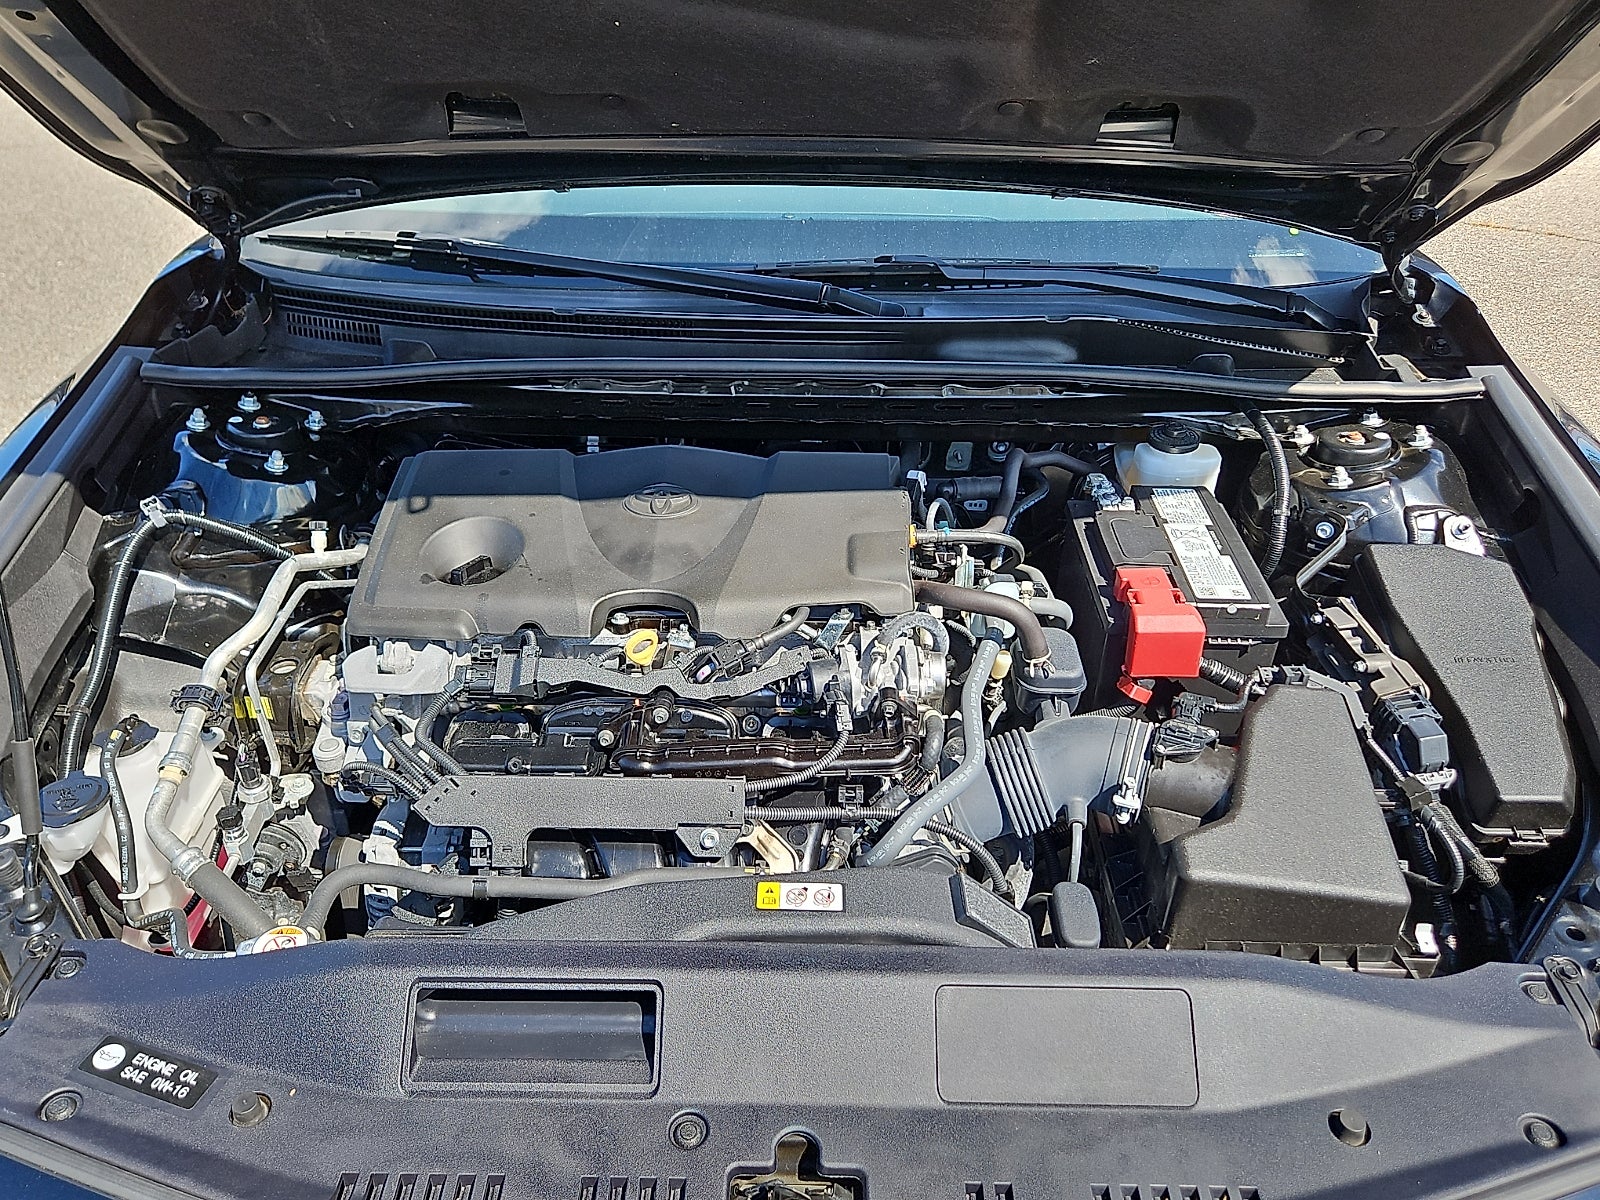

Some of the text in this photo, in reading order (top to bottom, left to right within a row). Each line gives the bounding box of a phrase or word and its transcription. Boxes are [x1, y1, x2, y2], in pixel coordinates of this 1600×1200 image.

[120, 1065, 190, 1099] SAE 0W-16
[131, 1052, 201, 1086] ENGINE OIL
